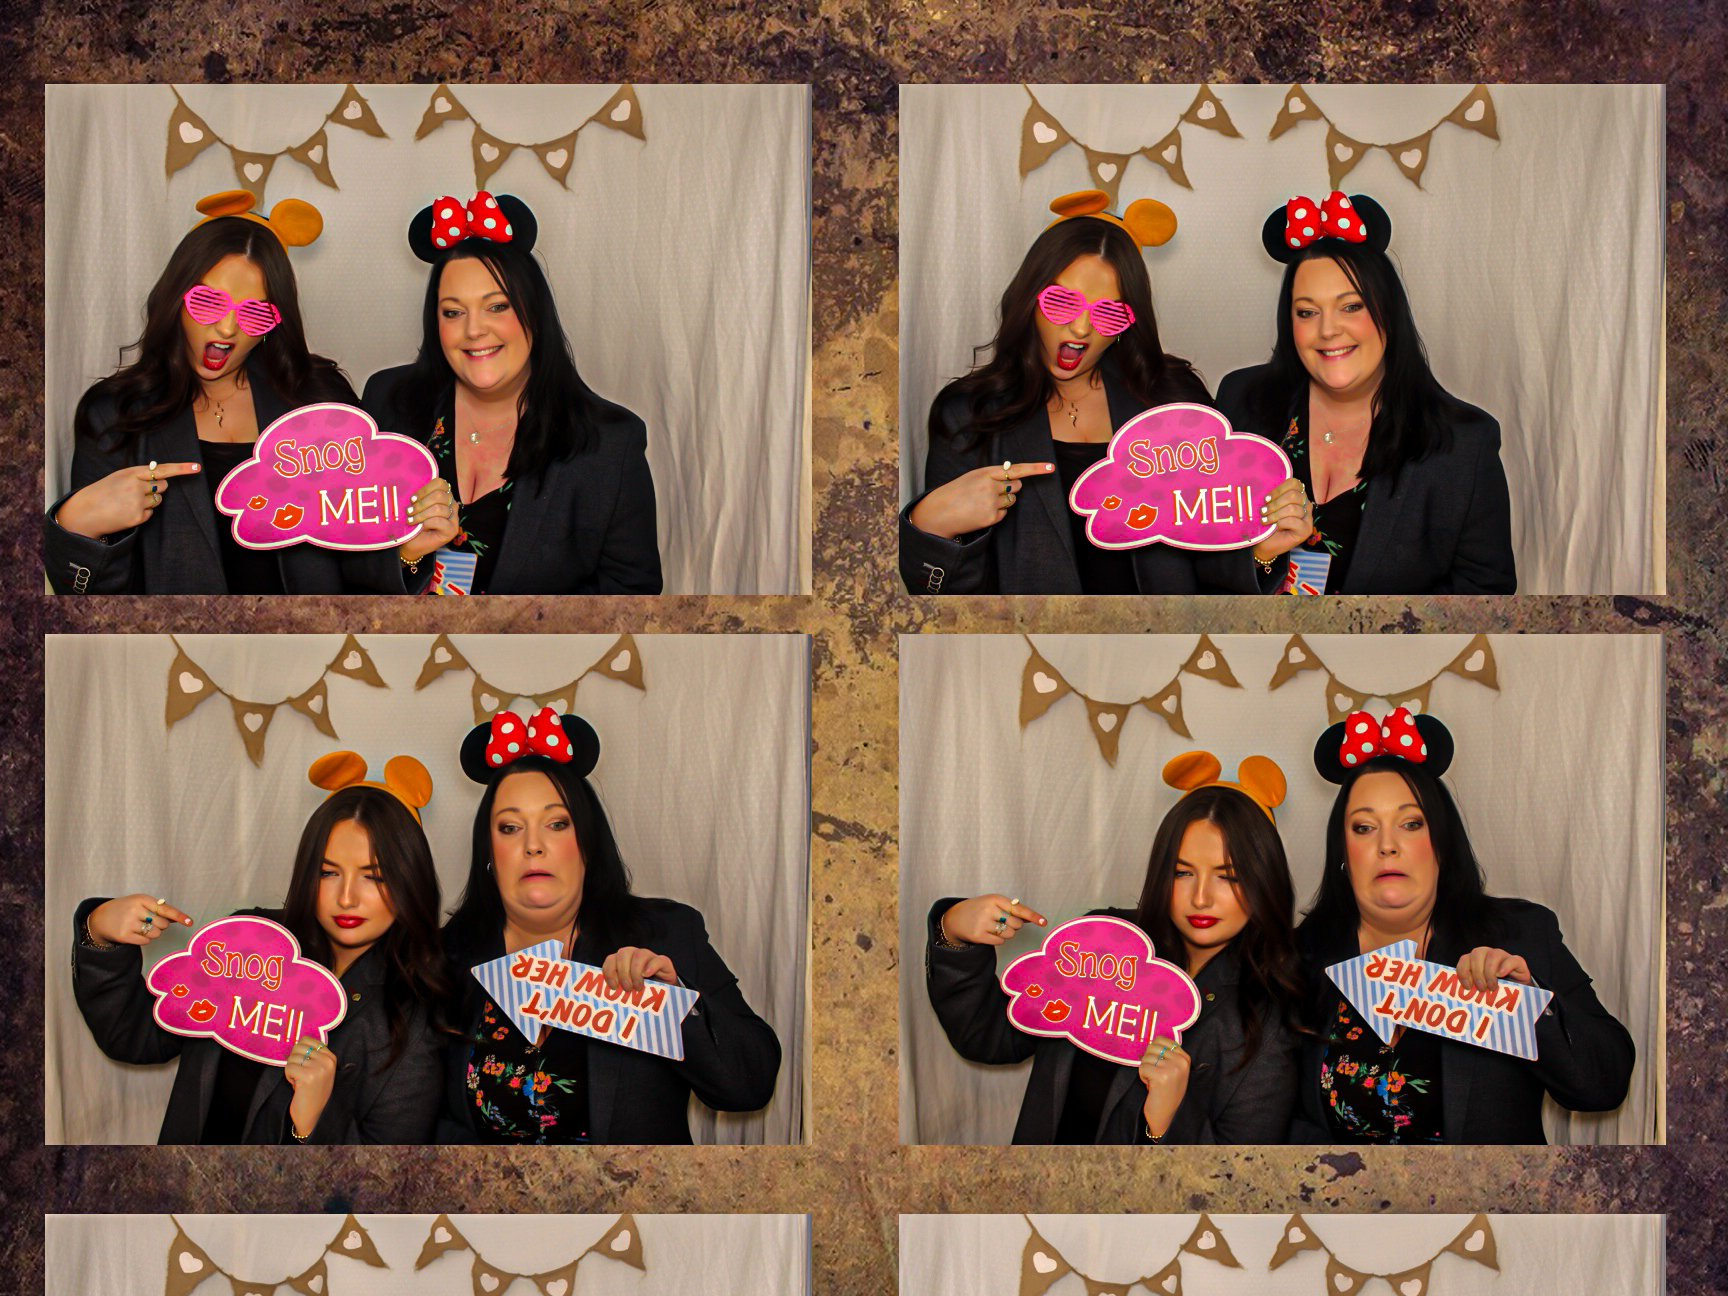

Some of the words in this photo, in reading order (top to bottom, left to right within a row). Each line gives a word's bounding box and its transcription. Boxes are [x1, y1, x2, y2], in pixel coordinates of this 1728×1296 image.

[273, 436, 365, 478] Snog
[1127, 436, 1219, 478] Snog
[318, 484, 399, 525] ME!!
[1172, 484, 1253, 525] ME!!
[200, 941, 284, 991] Snog
[510, 953, 570, 990] HER
[1054, 941, 1138, 991] Snog
[1364, 953, 1424, 990] HER
[228, 995, 304, 1045] ME!!
[520, 989, 616, 1035] DON'T
[619, 1014, 638, 1041] I
[1082, 995, 1158, 1045] ME!!
[1374, 989, 1470, 1035] DON'T
[1473, 1014, 1492, 1041] I
